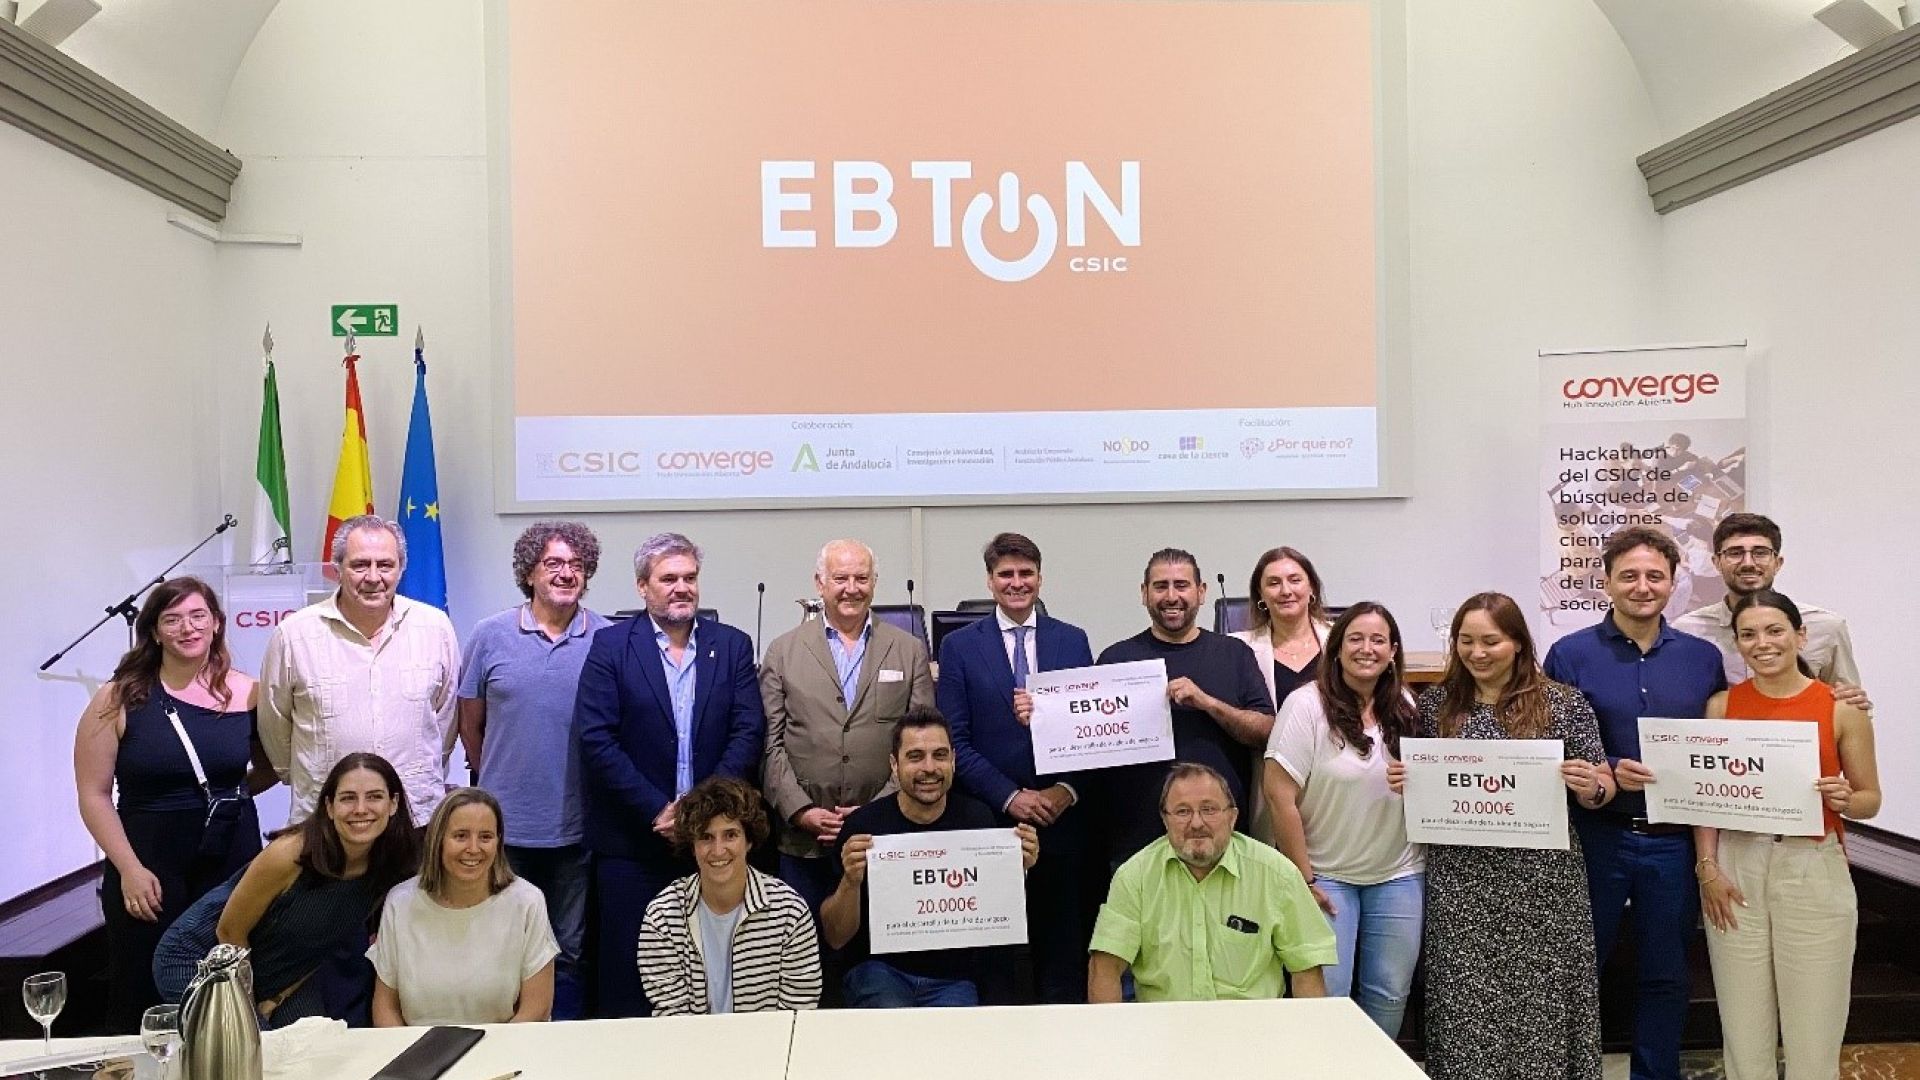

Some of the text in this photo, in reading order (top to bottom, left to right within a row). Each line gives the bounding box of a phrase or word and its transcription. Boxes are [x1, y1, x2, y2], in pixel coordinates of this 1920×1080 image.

[1069, 257, 1128, 272] CSIC
[1563, 372, 1719, 404] converge
[1563, 401, 1582, 409] Hub
[826, 447, 855, 457] Junta
[1267, 438, 1299, 452] ¿Por
[1329, 437, 1353, 449] no?
[1179, 451, 1189, 460] de
[1560, 445, 1667, 461] Hackathon
[558, 452, 640, 473] CSIC
[657, 450, 774, 475] converge
[826, 458, 892, 470] de Andalucía
[1559, 466, 1671, 483] del CSIC de
[1560, 488, 1689, 508] búsqueda de
[1560, 511, 1663, 526] soluciones
[1560, 532, 1614, 547] cient
[1560, 557, 1602, 571] para
[1560, 575, 1605, 590] de la
[1074, 721, 1130, 739] 20.000€
[1695, 781, 1764, 800] 20.000€
[1452, 799, 1516, 816] 20.000€
[916, 896, 978, 914] 20.000€
